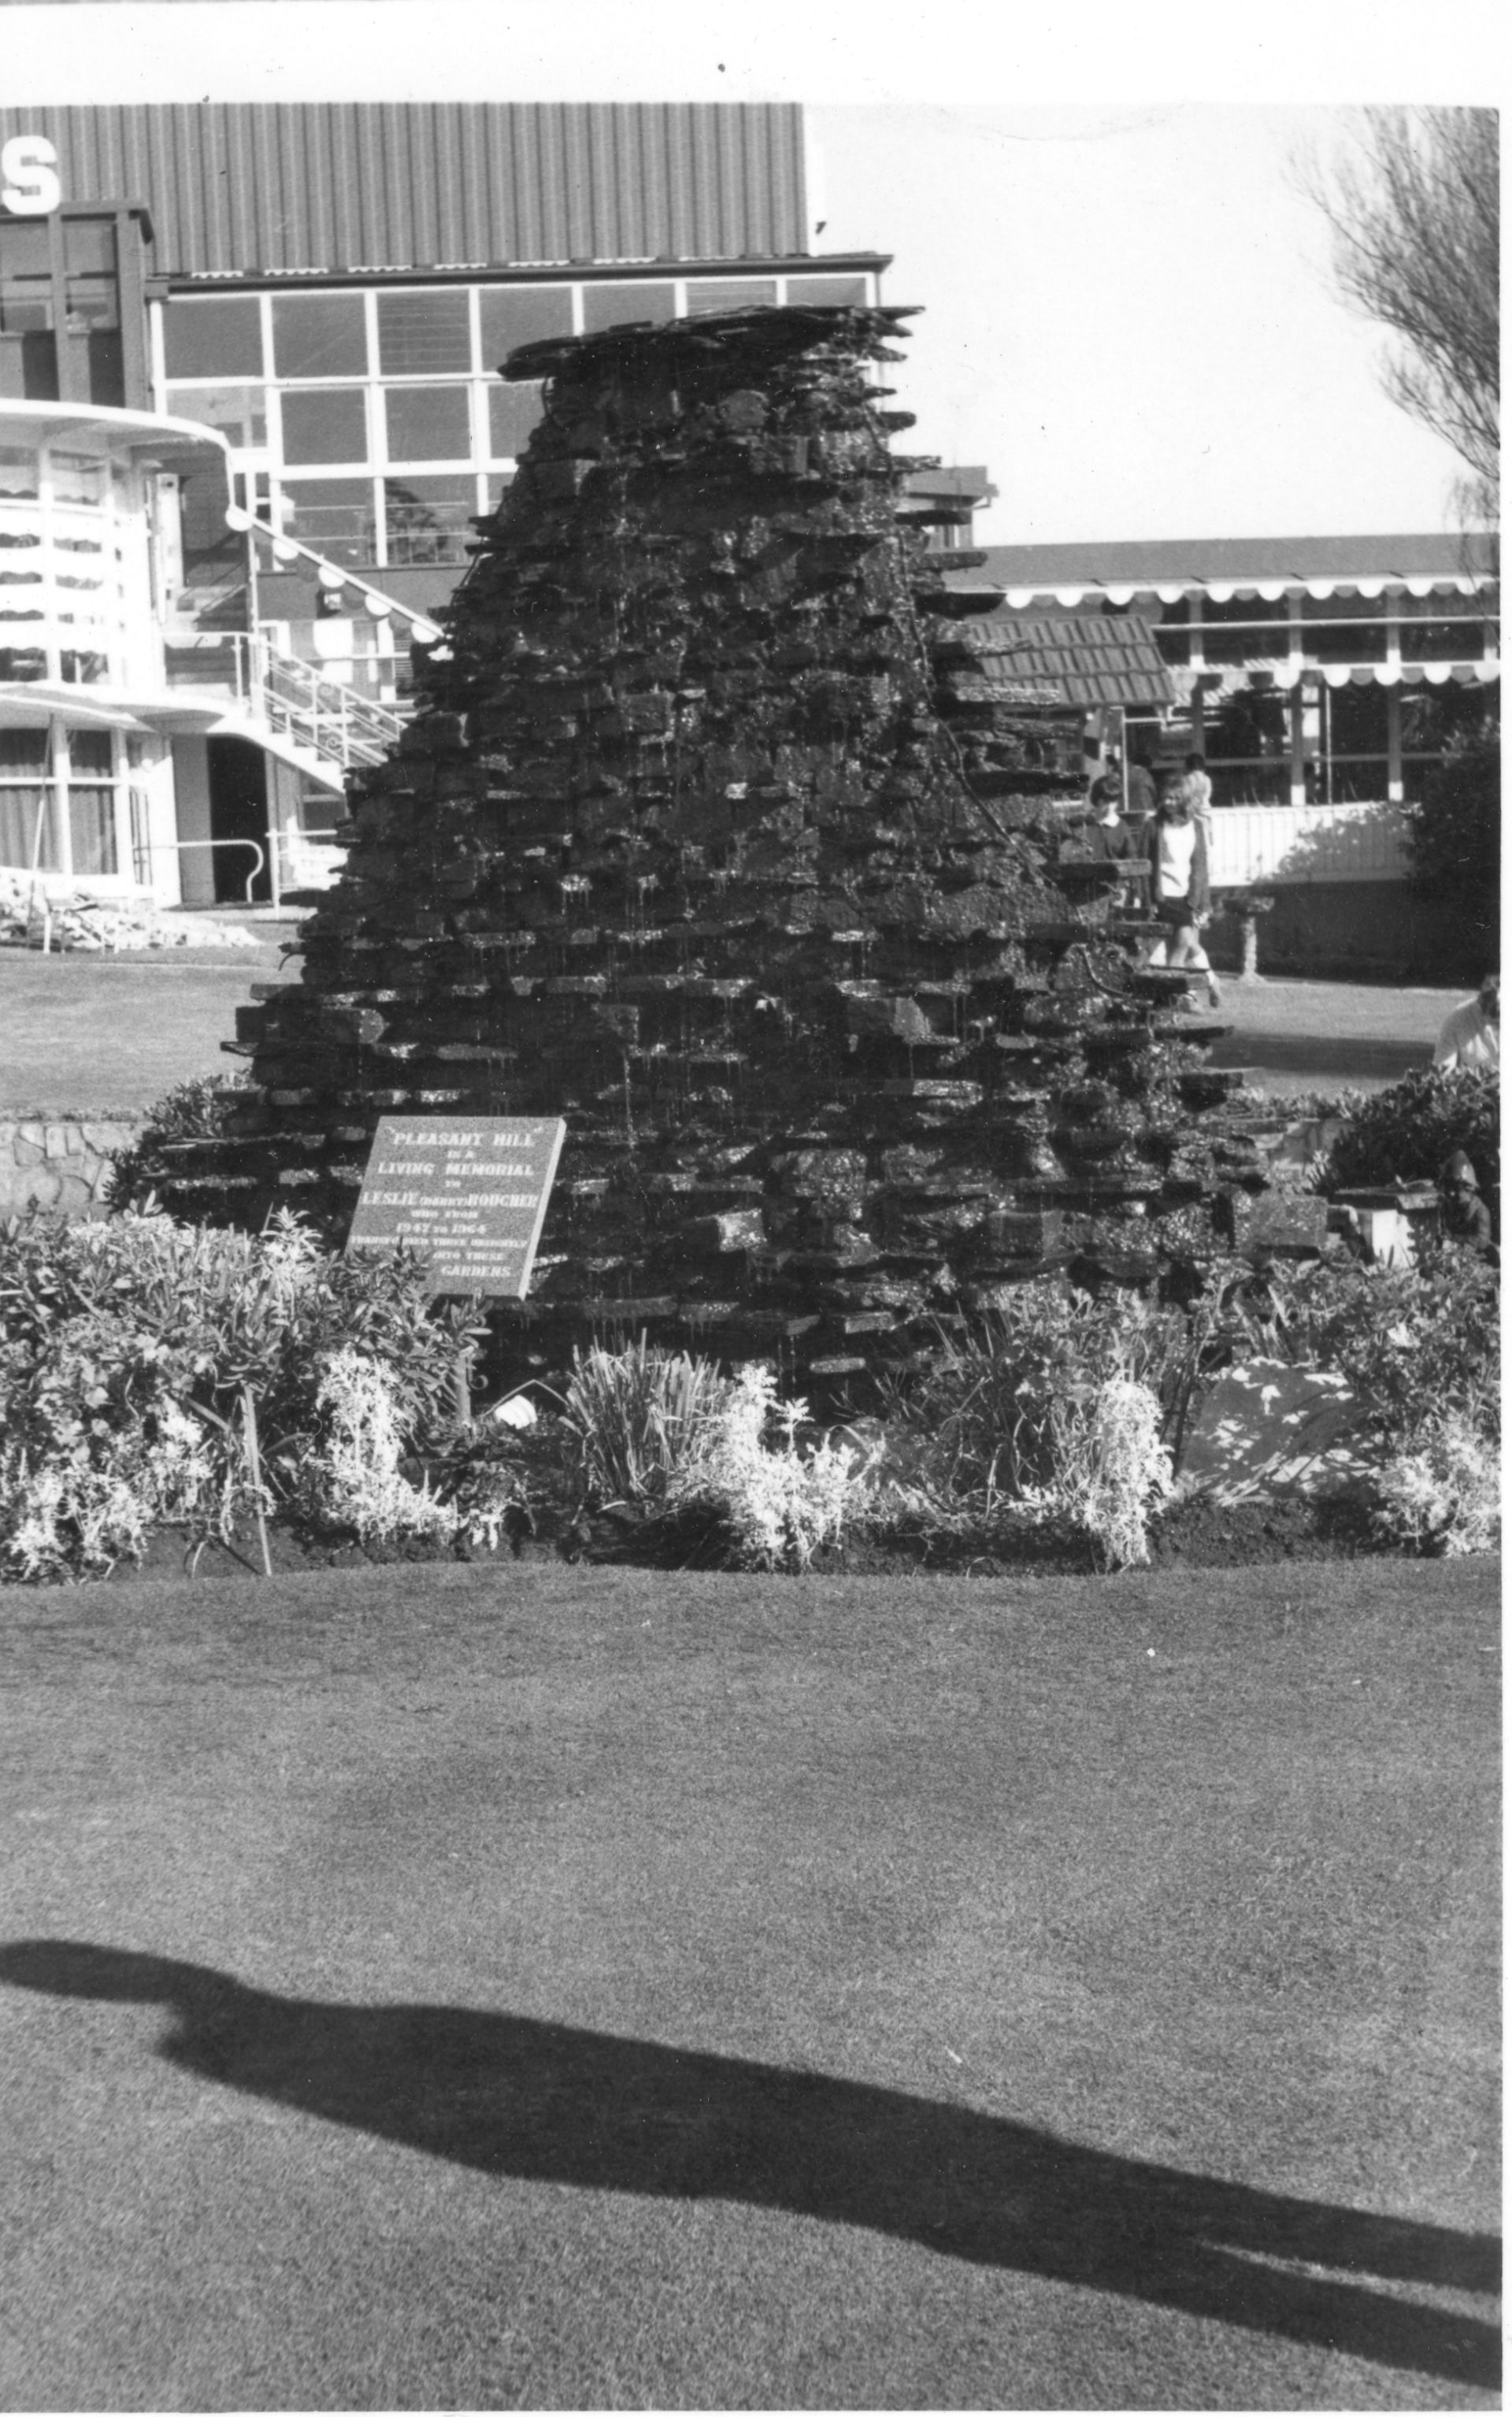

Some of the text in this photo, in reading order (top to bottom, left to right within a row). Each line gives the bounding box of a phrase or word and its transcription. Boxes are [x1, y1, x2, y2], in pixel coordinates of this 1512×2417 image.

[378, 1162, 534, 1176] LIVING MEMORIAL
[362, 1191, 420, 1205] LESLIE
[411, 1210, 479, 1219] WHO FROM
[396, 1222, 431, 1233] 1947
[441, 1265, 512, 1277] GARDENS
